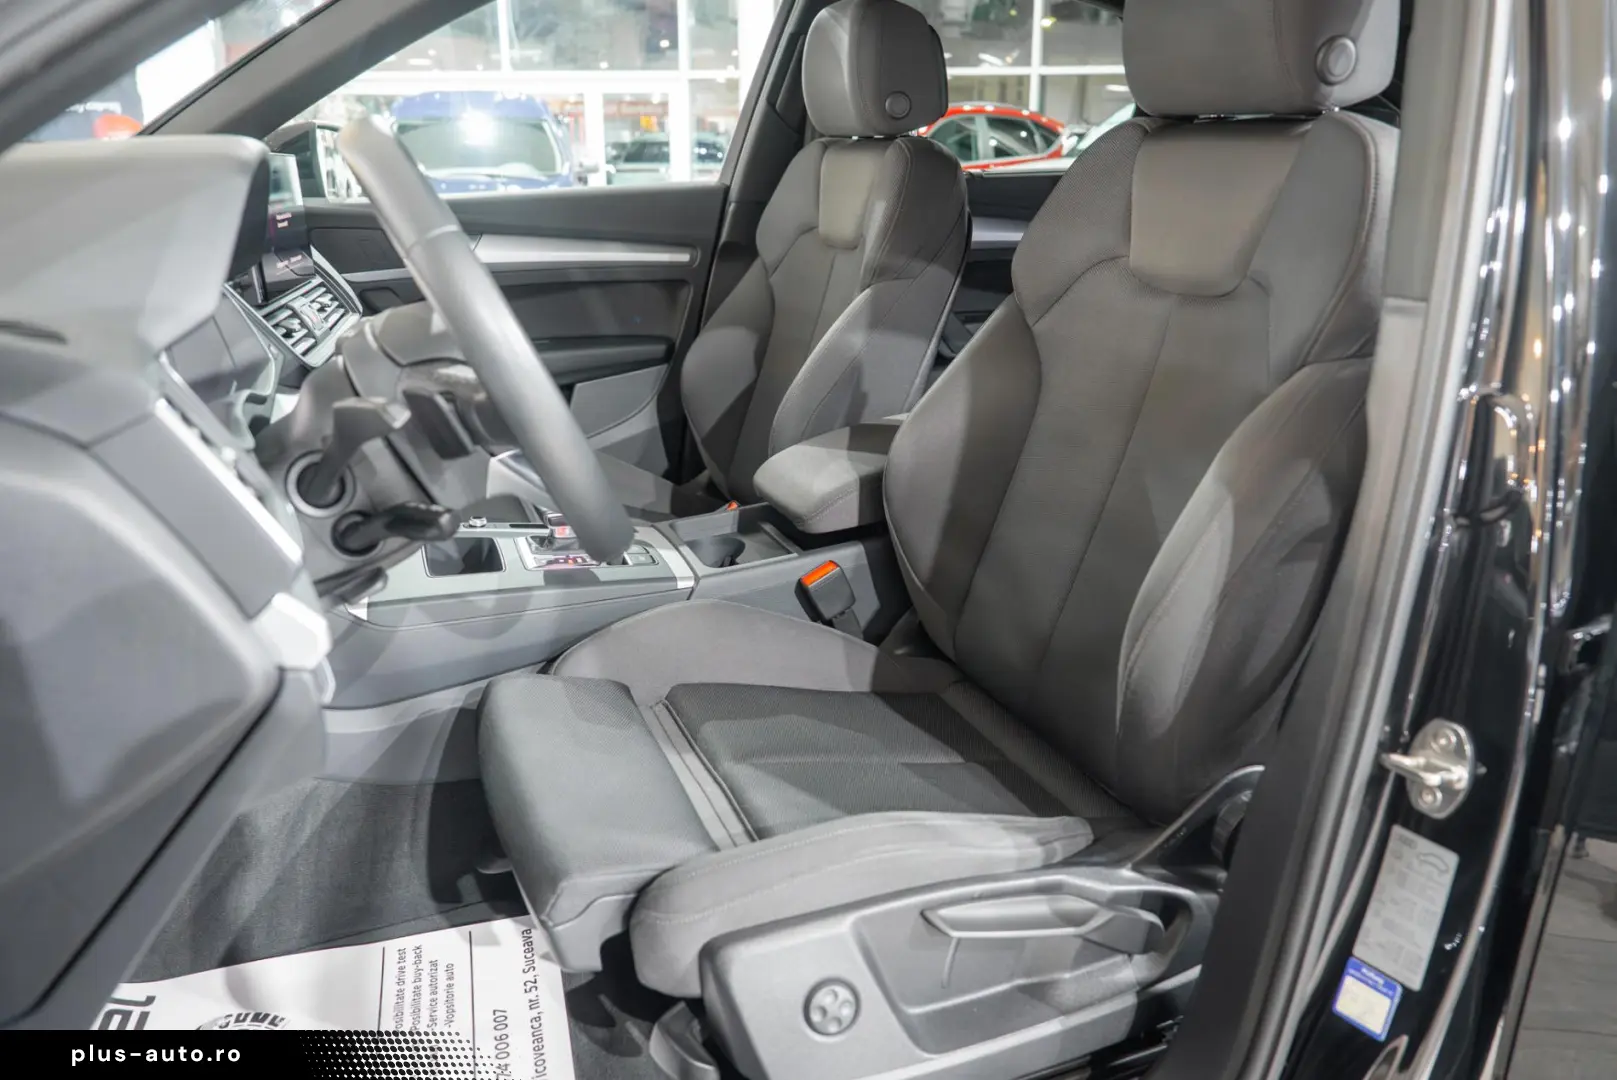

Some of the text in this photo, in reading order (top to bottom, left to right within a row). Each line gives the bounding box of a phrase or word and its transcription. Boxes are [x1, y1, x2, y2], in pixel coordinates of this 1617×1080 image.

[397, 947, 406, 964] test
[411, 945, 424, 984] buy-back
[395, 965, 406, 986] drive
[428, 959, 438, 996] autorizat
[444, 962, 454, 981] auto
[521, 928, 548, 1080] icoveanca, nr. 52, Suceava
[493, 1009, 508, 1032] 007
[494, 1033, 510, 1060] 006
